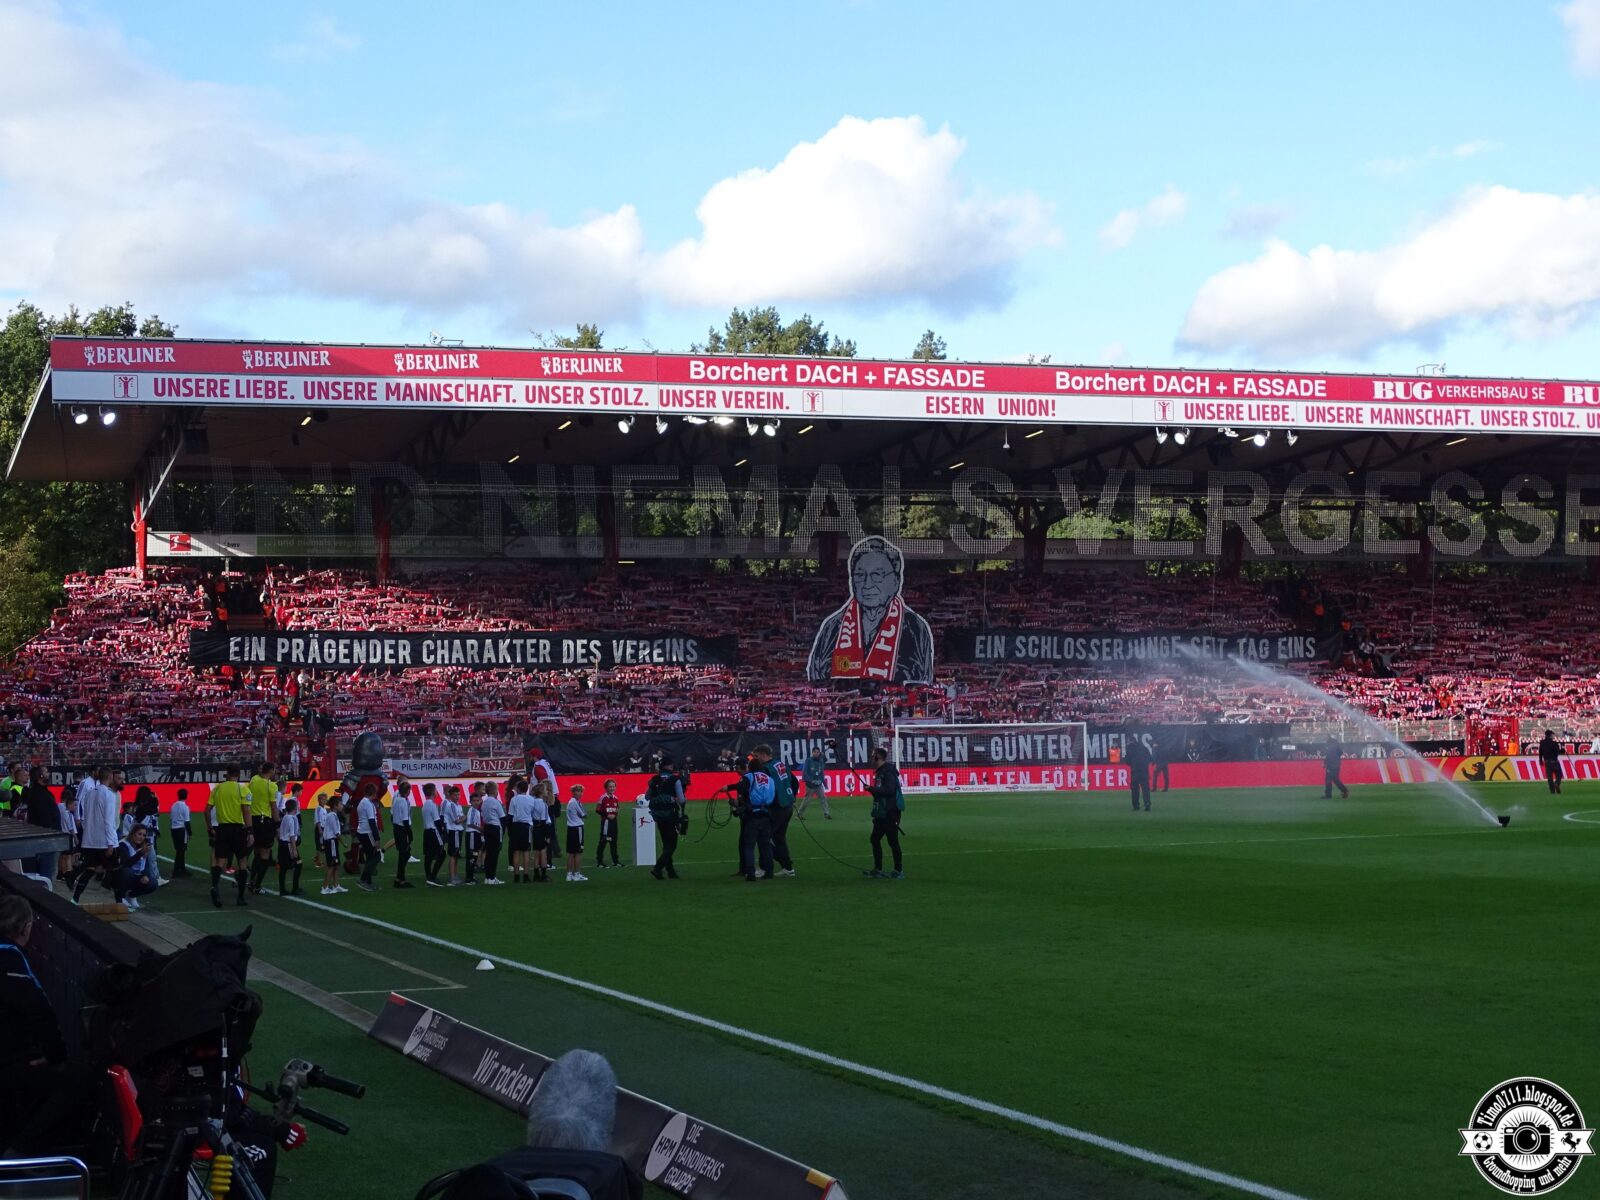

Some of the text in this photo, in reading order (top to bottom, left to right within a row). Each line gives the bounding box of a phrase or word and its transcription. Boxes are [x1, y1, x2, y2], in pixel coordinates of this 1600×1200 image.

[96, 346, 175, 365] BERLINER
[254, 350, 331, 369] BERLINER
[405, 353, 480, 372] BERLINER
[552, 357, 624, 376] BERLINER
[689, 360, 788, 383] Borchert
[796, 364, 858, 385] DACH
[884, 366, 986, 388] FASSADE
[1055, 371, 1146, 393] Borchert
[1153, 375, 1210, 395] DACH
[1233, 377, 1327, 397] FASSADE
[153, 377, 790, 411] UNSERE LIEBE. UNSERE MANNSCHAFT. UNSER STOLZ. UNSER VEREIN.
[1372, 380, 1546, 401] BUG VERKEHRSBAU SE
[925, 395, 1056, 417] EISERN UNION!
[1184, 402, 1244, 421] UNSERE
[1250, 404, 1295, 422] LIEBE.
[1305, 406, 1364, 424] UNSERE
[1370, 407, 1475, 426] MANNSCHAFT.
[1481, 409, 1529, 427] UNSER
[1532, 411, 1580, 428] STOLZ.
[480, 462, 1018, 555] NIEMALS
[229, 633, 699, 665] EIN PRÄGENDER CHARAKTER DES VEREINS
[975, 635, 1006, 659] EIN
[1190, 637, 1229, 659] SEIT
[1237, 638, 1270, 660] TAG
[1277, 636, 1316, 659] EINS
[780, 738, 836, 766] RUHE
[846, 737, 868, 764] IN
[878, 736, 968, 763] FRIEDEN
[990, 732, 1073, 762] GÜNTER
[401, 762, 462, 772] PILS-PIRANHAS
[919, 772, 957, 787] DER
[969, 770, 1031, 786] ALTEN
[472, 1047, 499, 1084] Wir
[490, 1063, 534, 1104] rocken
[685, 1123, 704, 1144] DIE
[654, 1135, 678, 1159] HPM
[674, 1144, 725, 1182] HANDWERKS
[663, 1166, 697, 1194] GRUPPE
